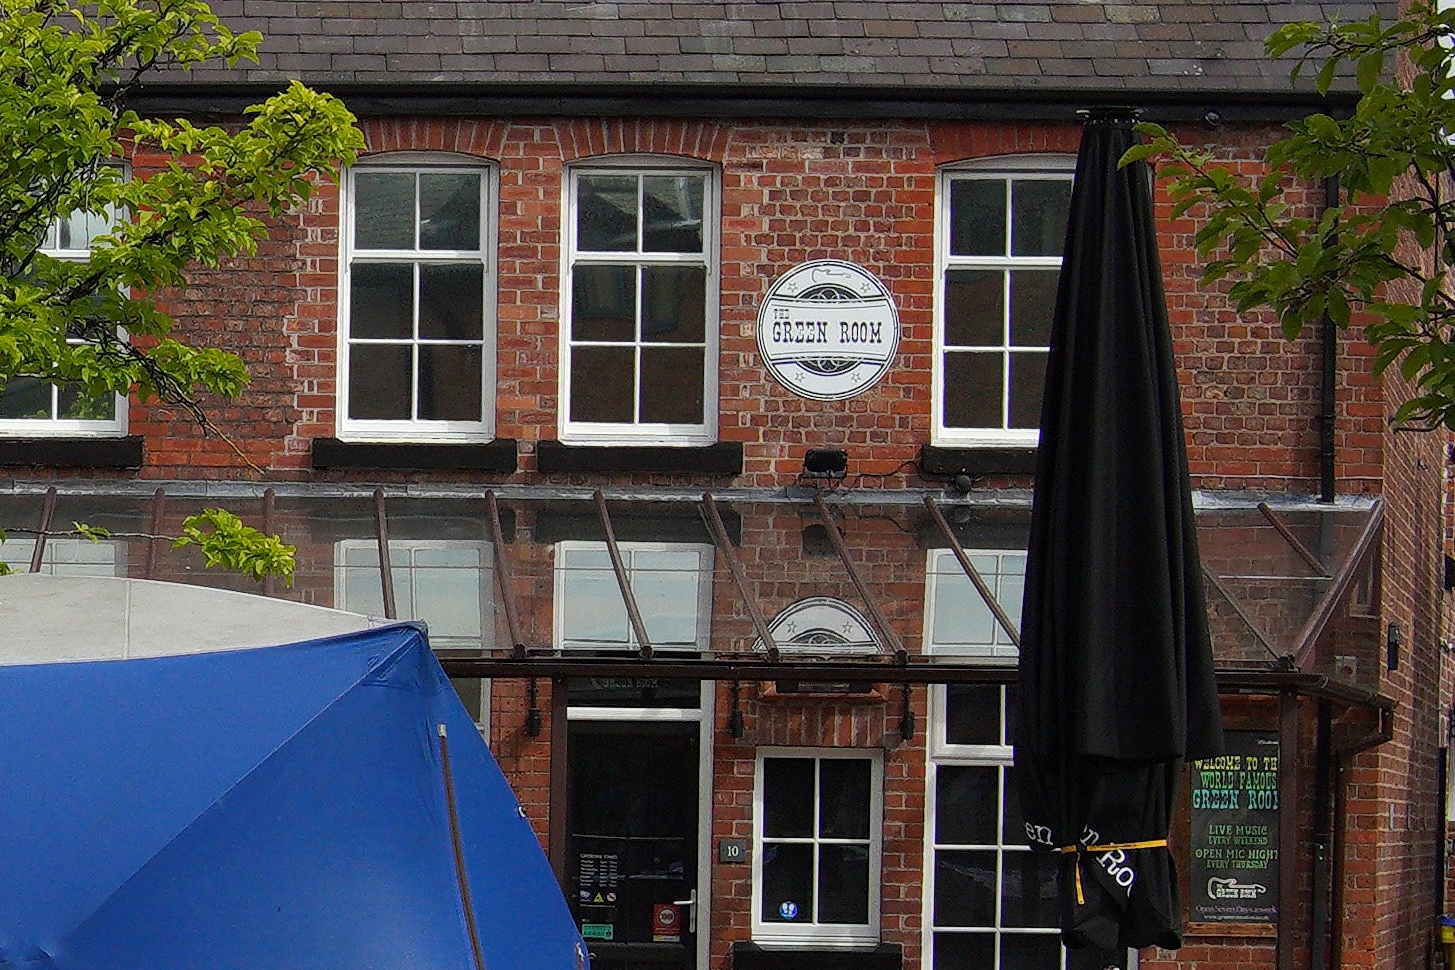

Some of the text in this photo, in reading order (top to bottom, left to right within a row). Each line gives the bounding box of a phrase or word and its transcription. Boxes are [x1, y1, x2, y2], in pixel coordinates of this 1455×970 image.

[773, 309, 789, 320] THE
[773, 322, 882, 343] GREEN ROOM
[1195, 755, 1278, 771] WELCOME TO TH
[1201, 772, 1277, 790] WORLD FAMOUS
[1193, 789, 1239, 809] GREEN
[1209, 825, 1267, 835] LIVE MUSIC
[728, 846, 739, 856] 10
[1195, 849, 1222, 859] OPEN
[1227, 849, 1245, 860] MIC
